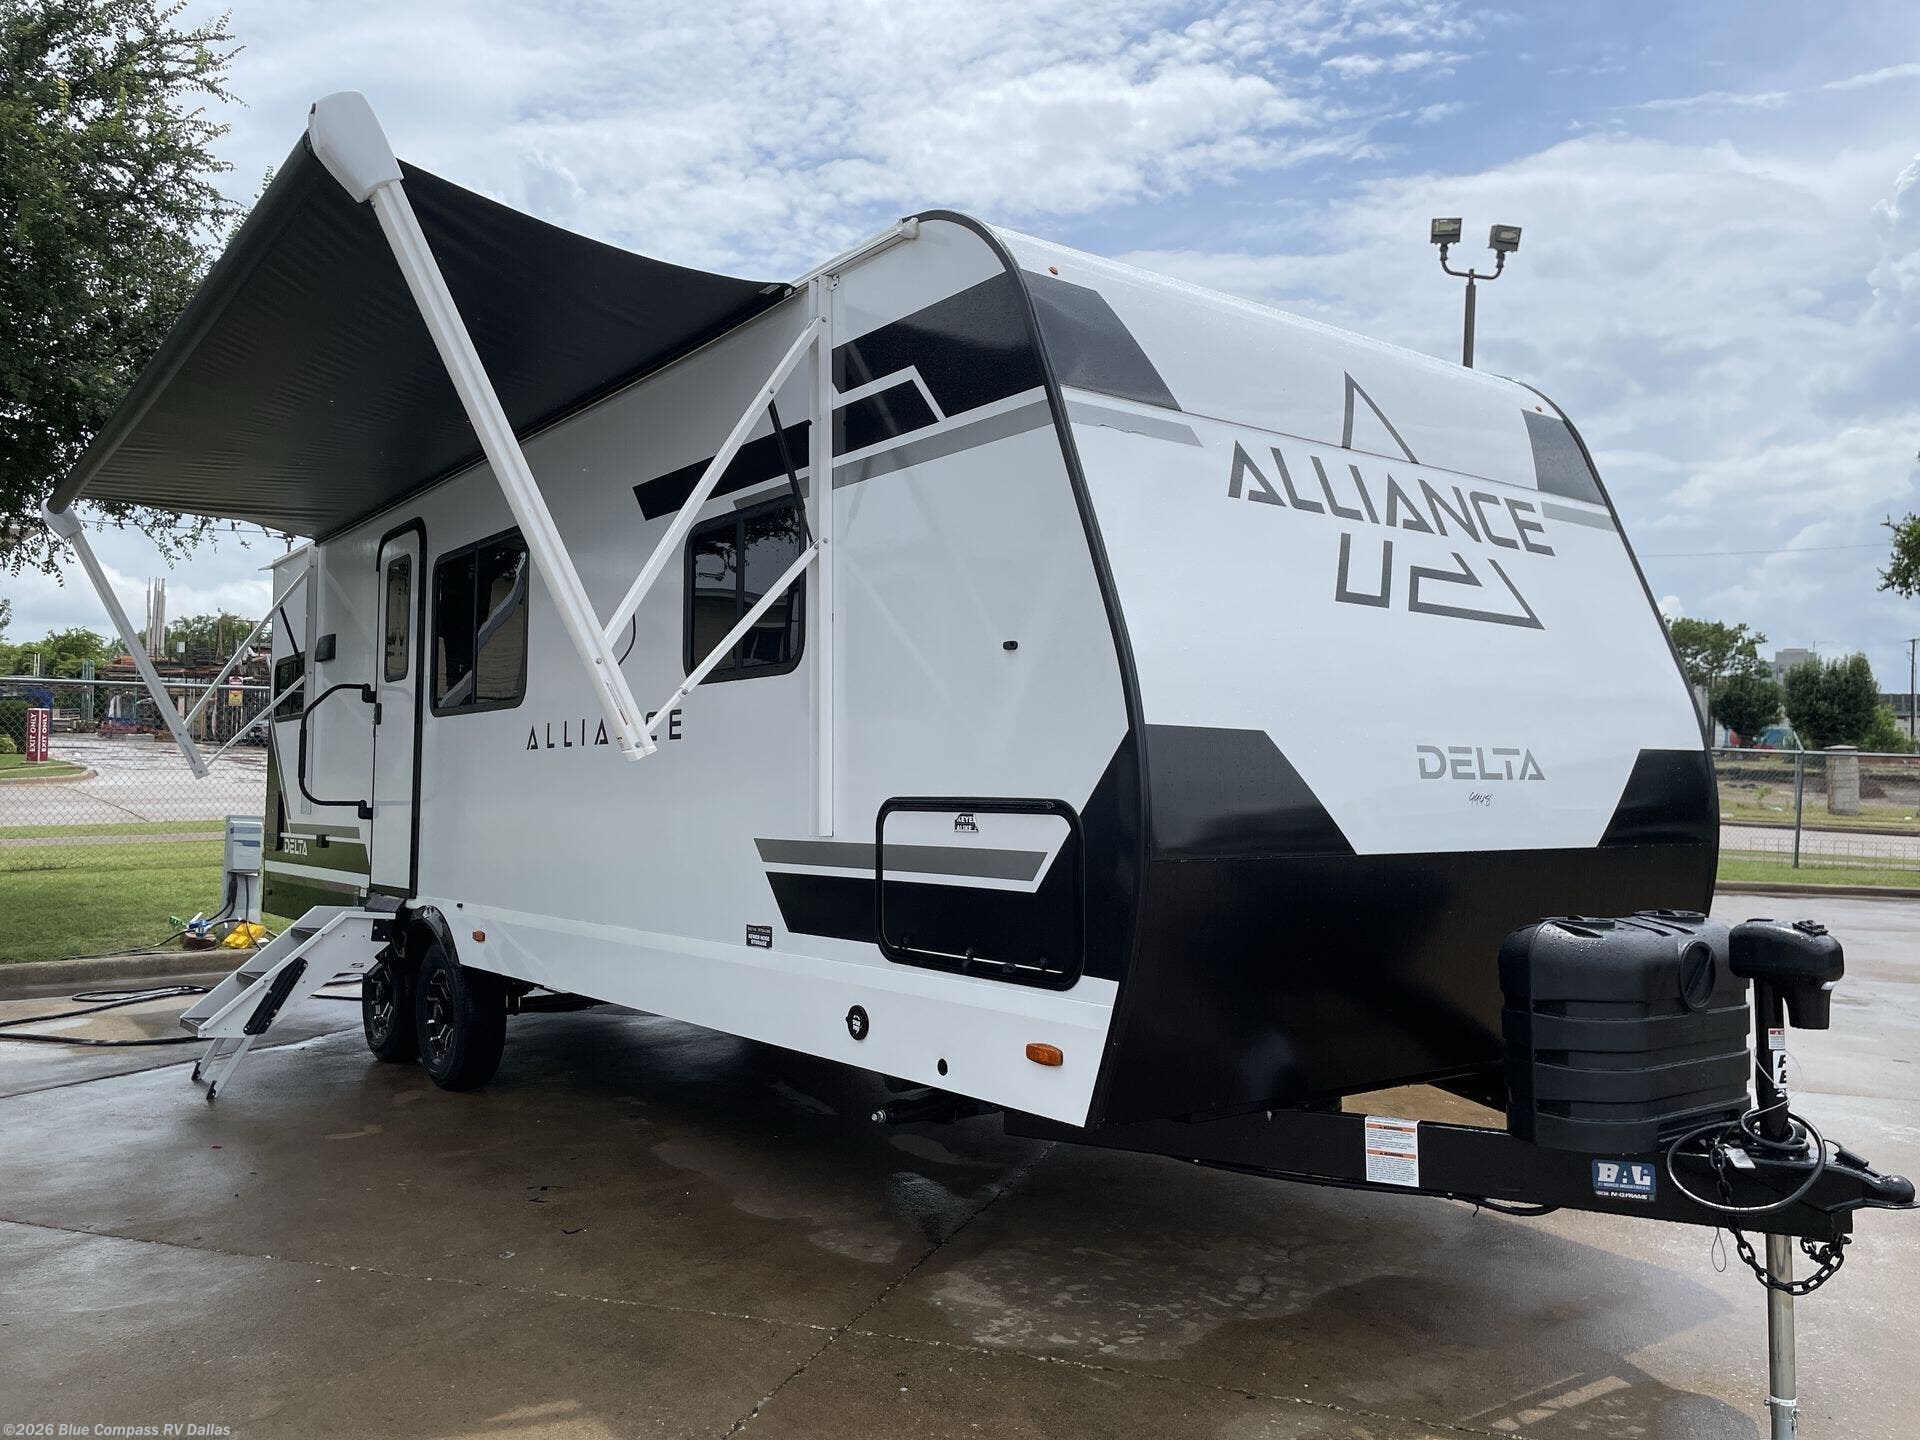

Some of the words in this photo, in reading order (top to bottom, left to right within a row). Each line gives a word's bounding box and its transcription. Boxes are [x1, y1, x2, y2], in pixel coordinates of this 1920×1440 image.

[1228, 440, 1556, 557] ALLIANCE
[526, 708, 682, 750] ALLIACE
[1416, 744, 1546, 780] DELTA
[284, 838, 308, 856] DELTA
